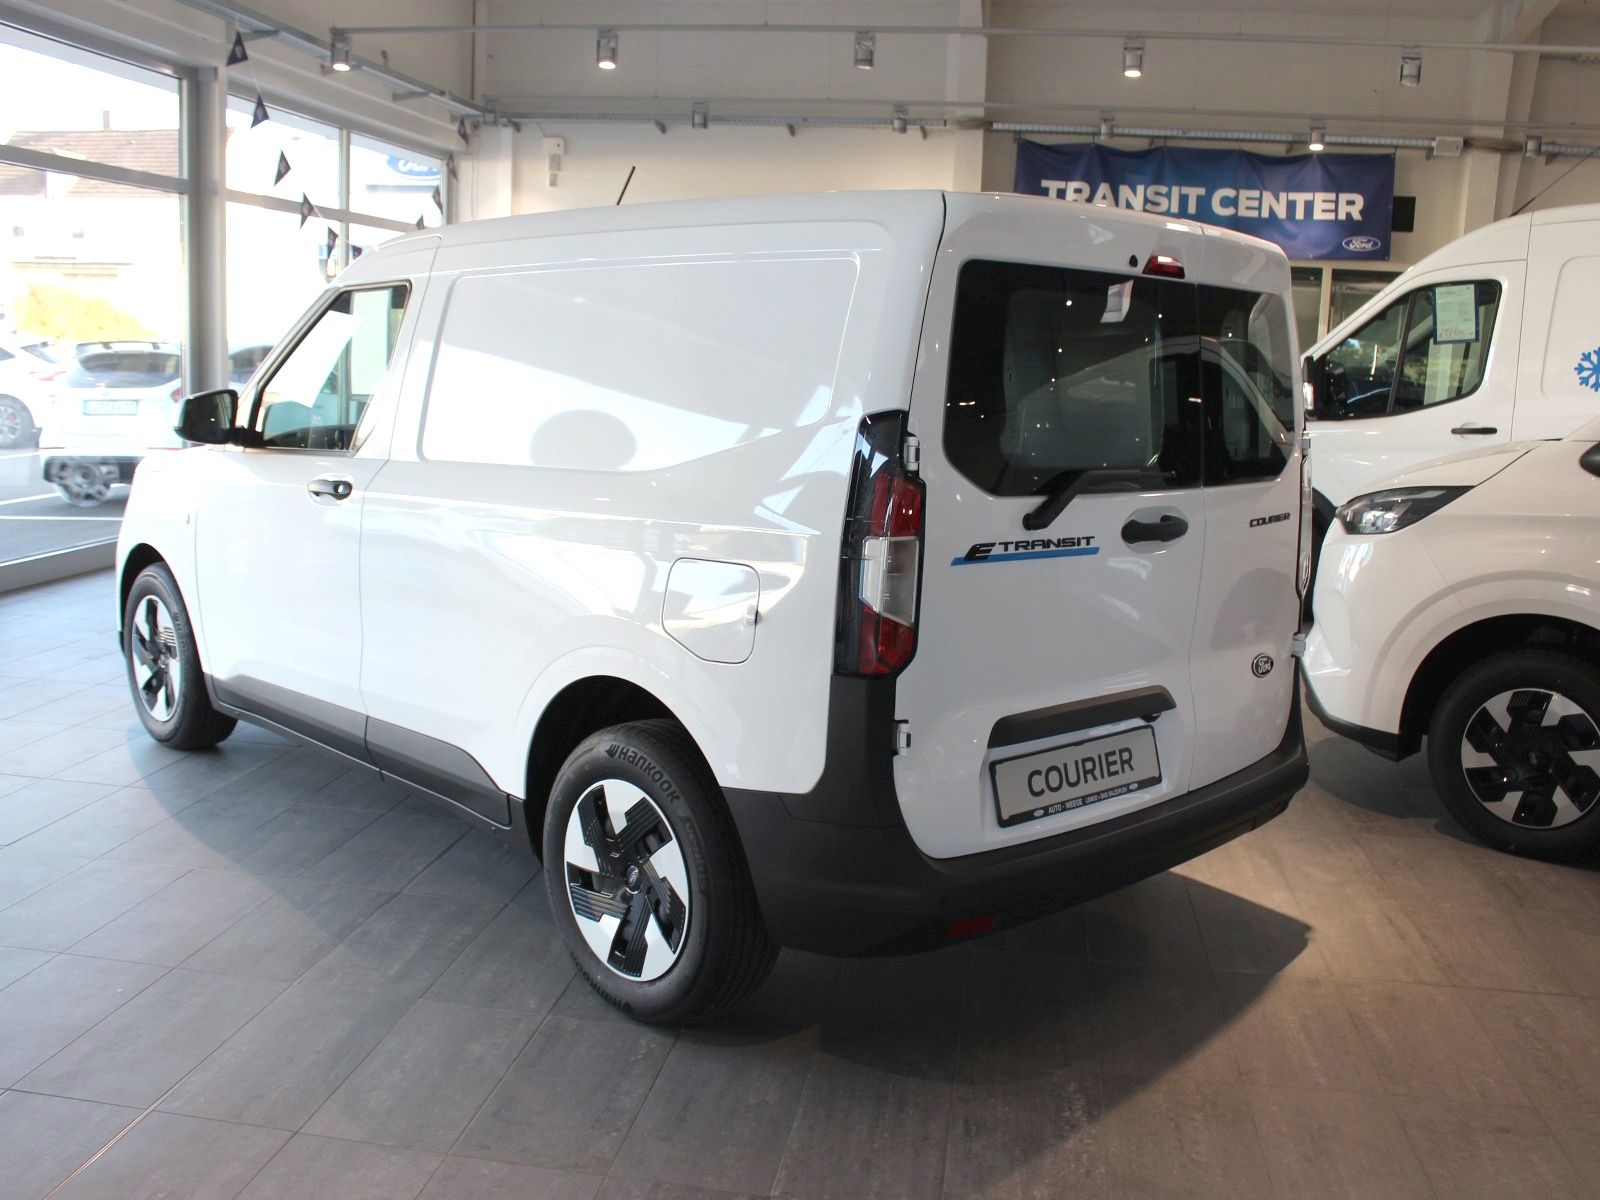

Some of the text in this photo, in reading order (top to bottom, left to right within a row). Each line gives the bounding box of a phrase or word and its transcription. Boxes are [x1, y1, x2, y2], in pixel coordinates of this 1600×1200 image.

[1041, 179, 1364, 221] TRANSIT CENTER
[1347, 237, 1376, 251] Ford
[1249, 512, 1291, 528] COURIER
[1027, 747, 1135, 797] COURIER
